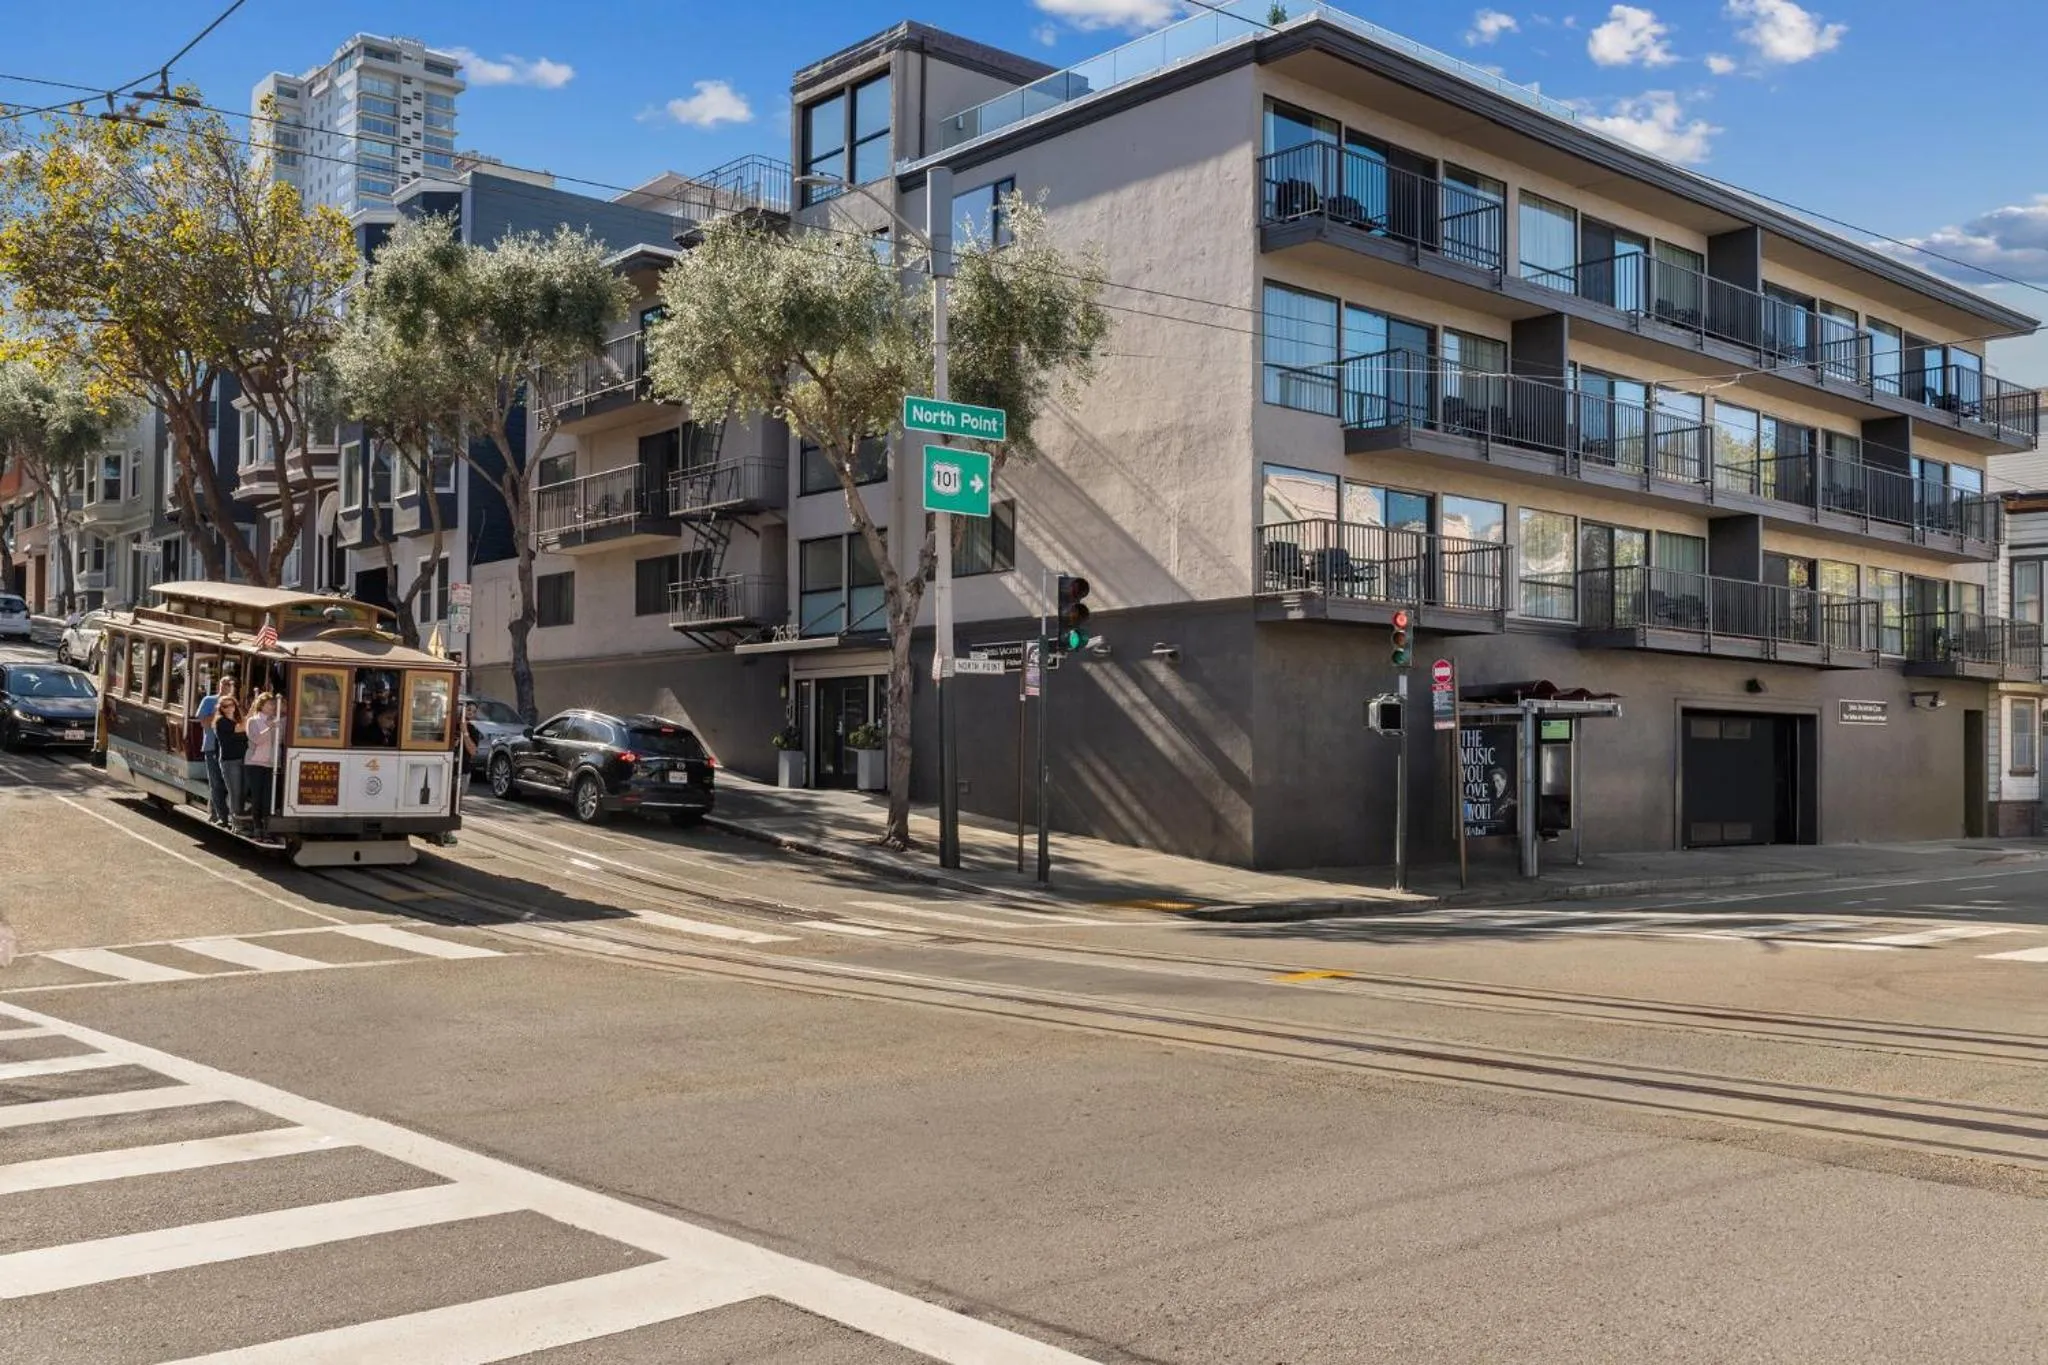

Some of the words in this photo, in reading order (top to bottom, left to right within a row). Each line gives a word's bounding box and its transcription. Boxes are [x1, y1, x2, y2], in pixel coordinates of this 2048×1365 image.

[912, 404, 956, 427] North
[960, 411, 998, 433] Point
[936, 470, 957, 489] 101
[957, 661, 978, 671] NORTH
[982, 662, 1001, 671] POINT
[1461, 729, 1482, 748] THE
[1461, 747, 1496, 766] MUSIC
[1461, 765, 1484, 783] YOU
[1465, 783, 1489, 798] OVE
